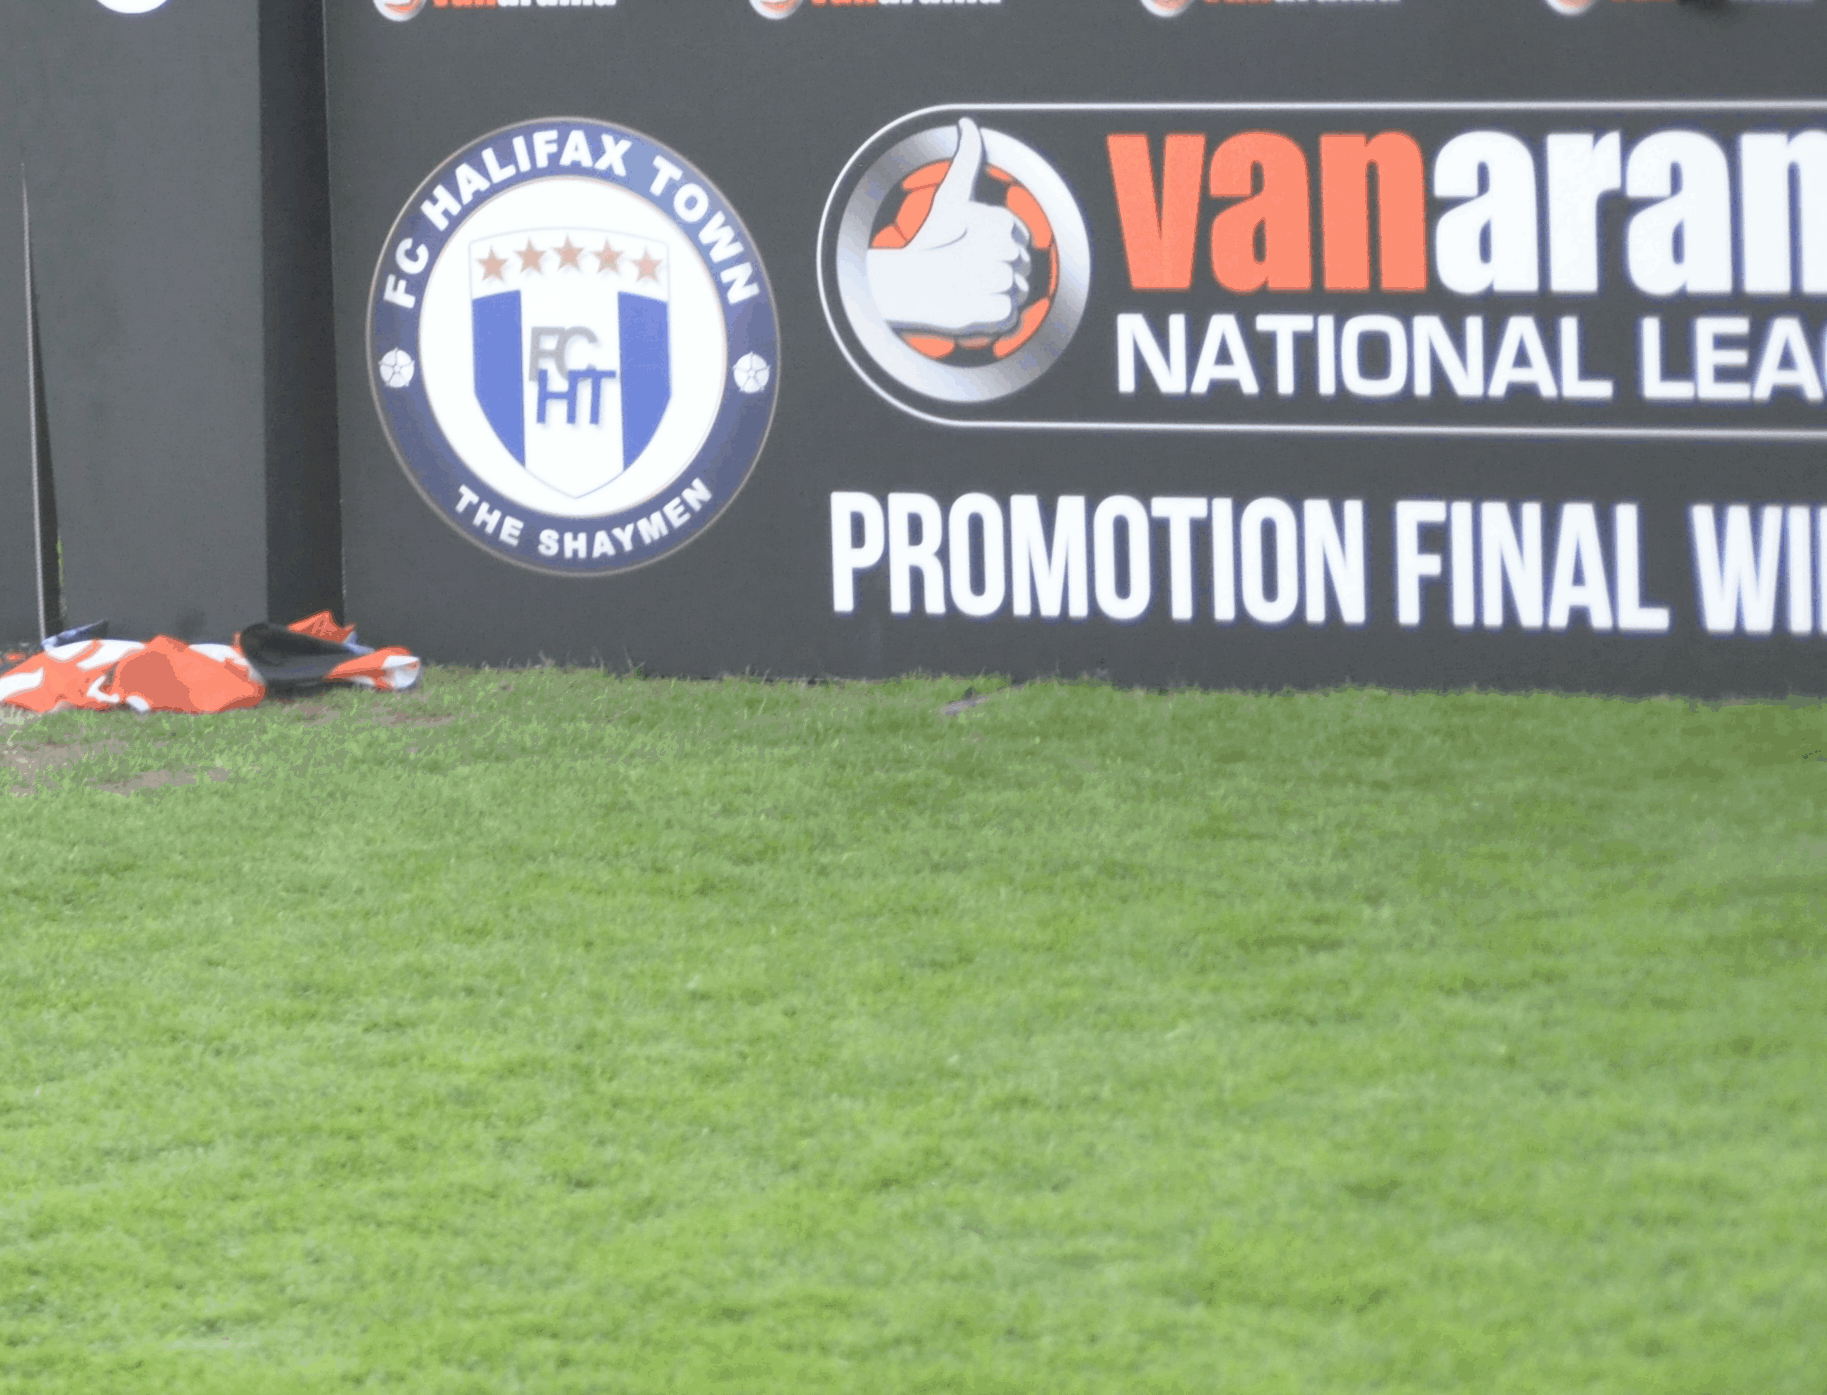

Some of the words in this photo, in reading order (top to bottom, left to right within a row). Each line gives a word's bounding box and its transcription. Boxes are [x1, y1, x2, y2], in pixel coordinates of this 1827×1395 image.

[383, 237, 430, 309] FC
[419, 129, 633, 232] HALIFAX
[649, 155, 760, 306] TOWN
[1106, 129, 1827, 297] vanaram
[1116, 312, 1614, 401] NATIONAL
[1639, 316, 1827, 402] LEA
[454, 485, 525, 547] THE
[537, 477, 713, 560] SHAYMEN
[829, 491, 1366, 628] PROMOTION
[1394, 499, 1670, 633] FINAL
